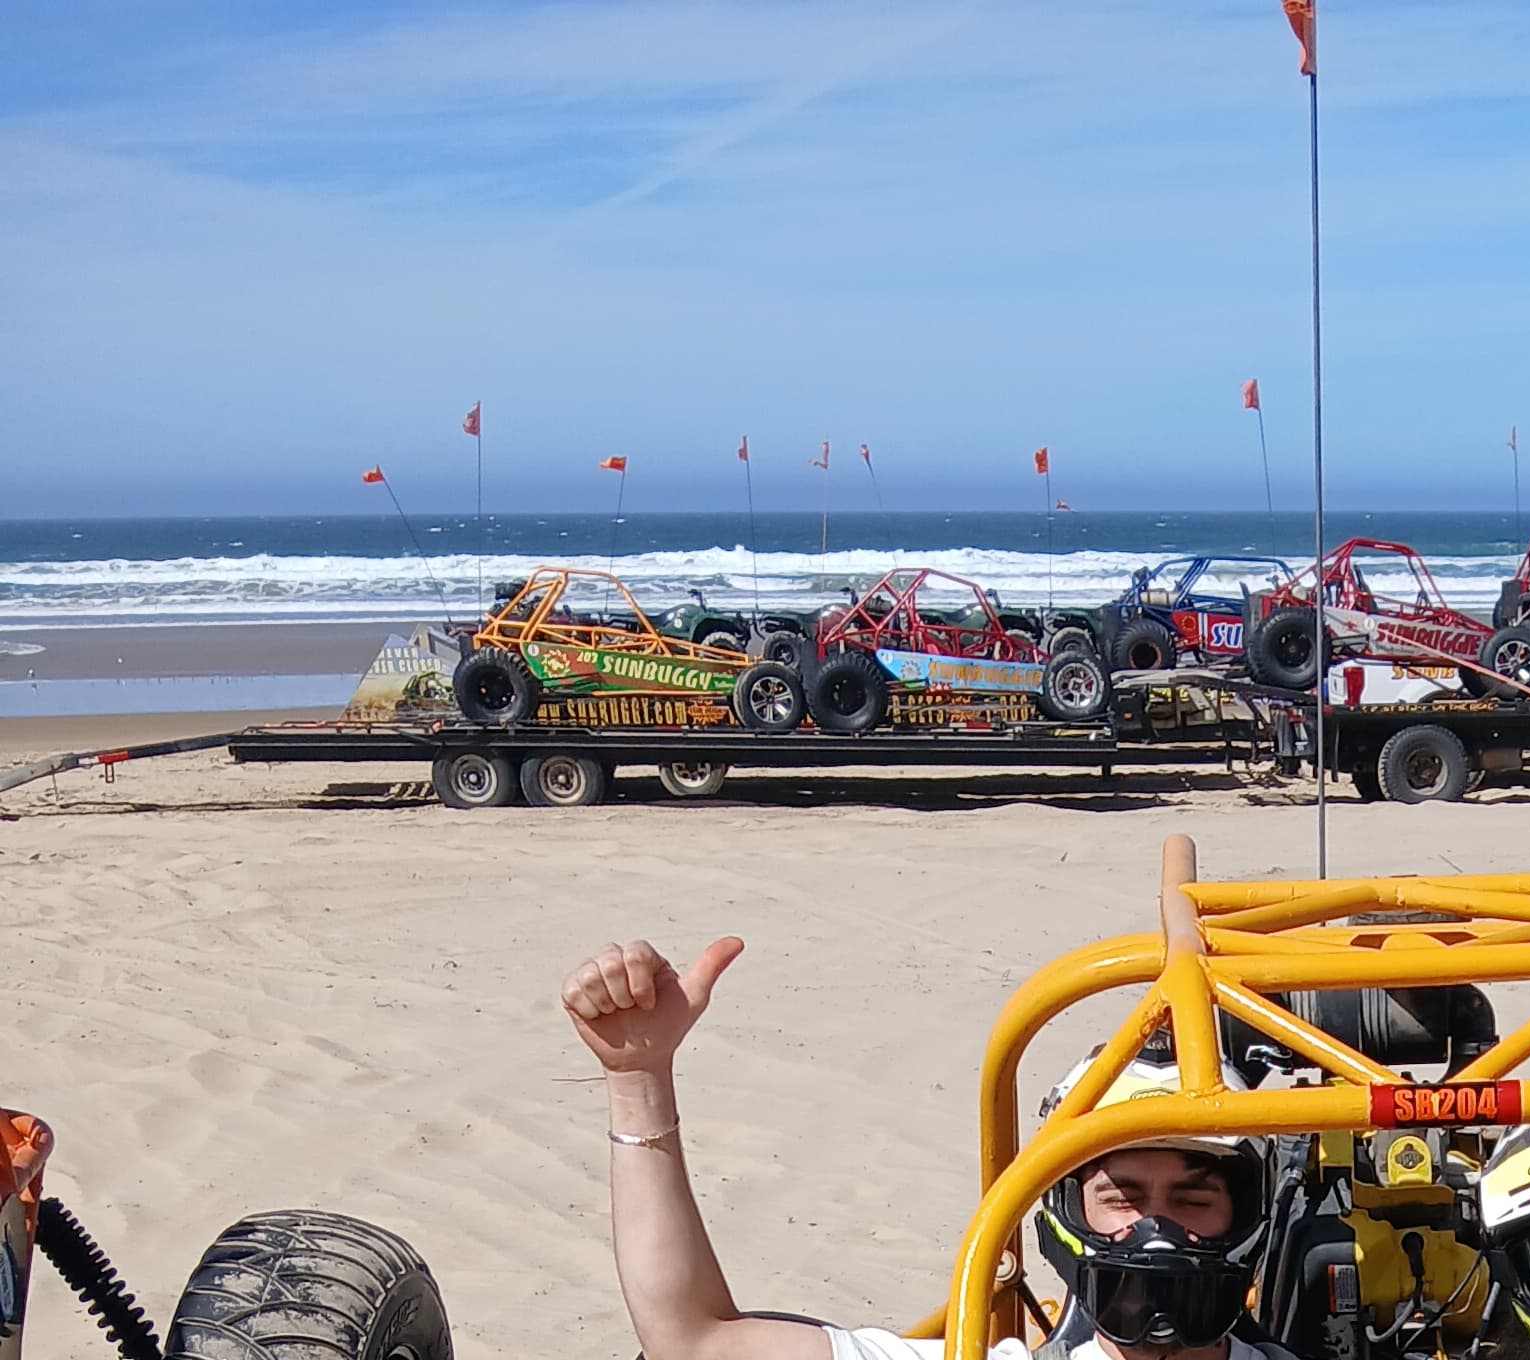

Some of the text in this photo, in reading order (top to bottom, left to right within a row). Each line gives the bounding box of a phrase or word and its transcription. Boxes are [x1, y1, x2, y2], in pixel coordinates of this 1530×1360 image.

[398, 658, 441, 673] CLOSED
[577, 650, 598, 664] 203
[602, 655, 713, 690] SUNBUGGY
[1394, 1087, 1498, 1121] SB204
